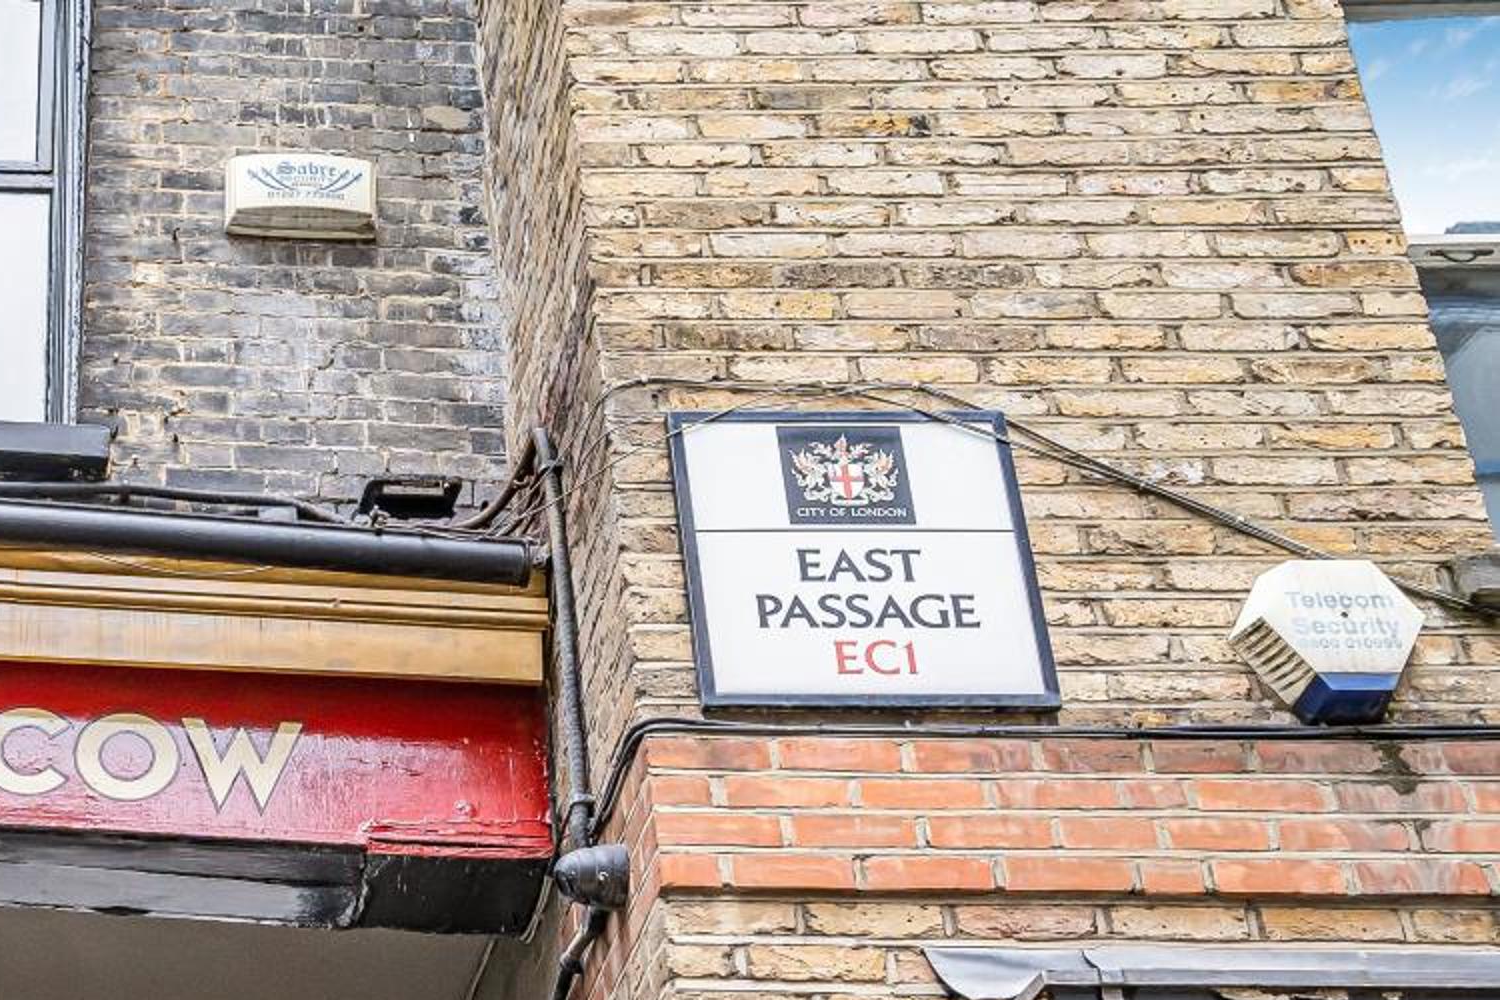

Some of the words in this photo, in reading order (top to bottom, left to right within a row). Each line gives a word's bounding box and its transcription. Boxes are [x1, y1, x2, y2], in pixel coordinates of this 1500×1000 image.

[797, 507, 826, 517] CITY
[829, 507, 846, 517] OF
[851, 507, 907, 517] LONDON
[796, 548, 921, 582] EAST
[755, 594, 981, 628] PASSAGE
[1284, 591, 1395, 609] Telecom
[1292, 617, 1400, 638] Security
[834, 640, 918, 675] EC1
